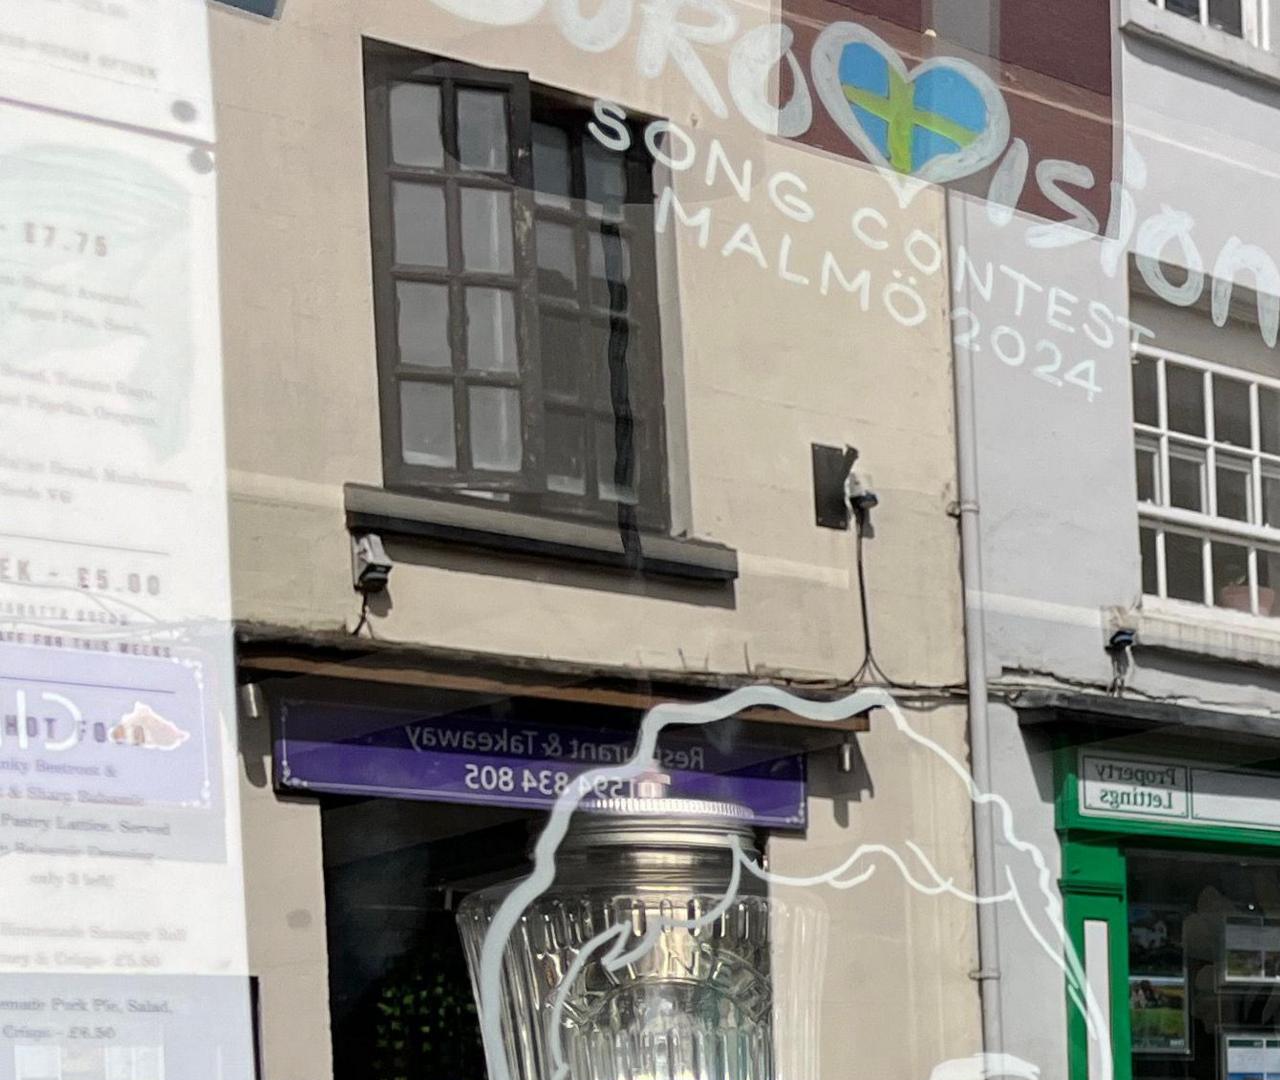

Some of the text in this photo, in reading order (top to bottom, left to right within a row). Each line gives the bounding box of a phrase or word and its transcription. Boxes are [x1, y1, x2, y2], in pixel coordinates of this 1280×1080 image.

[586, 98, 1156, 364] SONG CONTEST
[654, 187, 1103, 403] MALMÖ 2024
